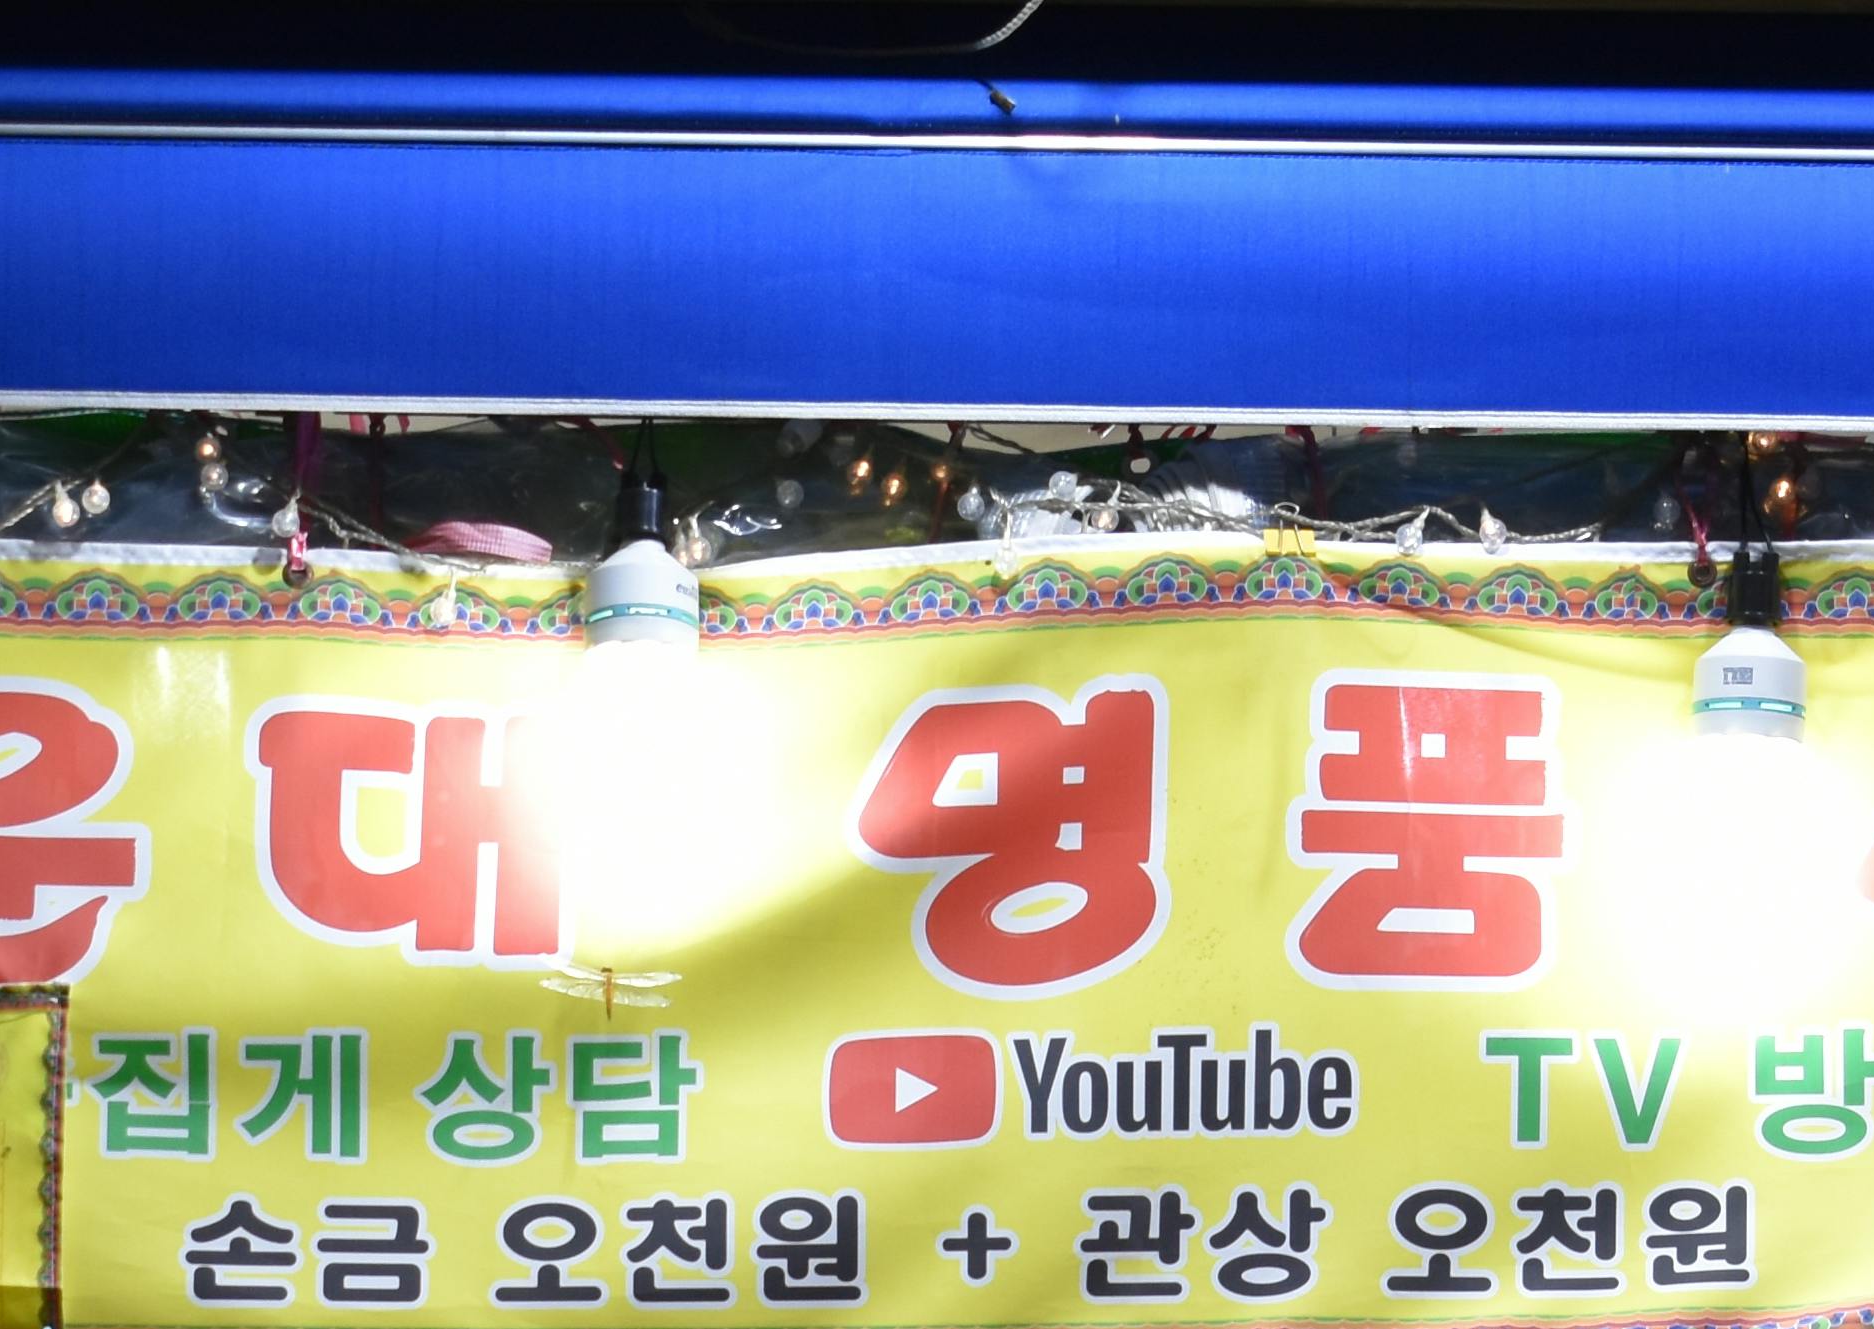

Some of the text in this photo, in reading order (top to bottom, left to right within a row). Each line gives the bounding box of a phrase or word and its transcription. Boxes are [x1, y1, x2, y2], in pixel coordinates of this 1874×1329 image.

[857, 682, 1565, 987] 명품
[417, 1033, 700, 1161] 상담
[1012, 1028, 1355, 1136] YouTube
[1483, 1035, 1682, 1147] TV
[181, 1184, 1753, 1303] 손금 오천원 + 관상 오천원
